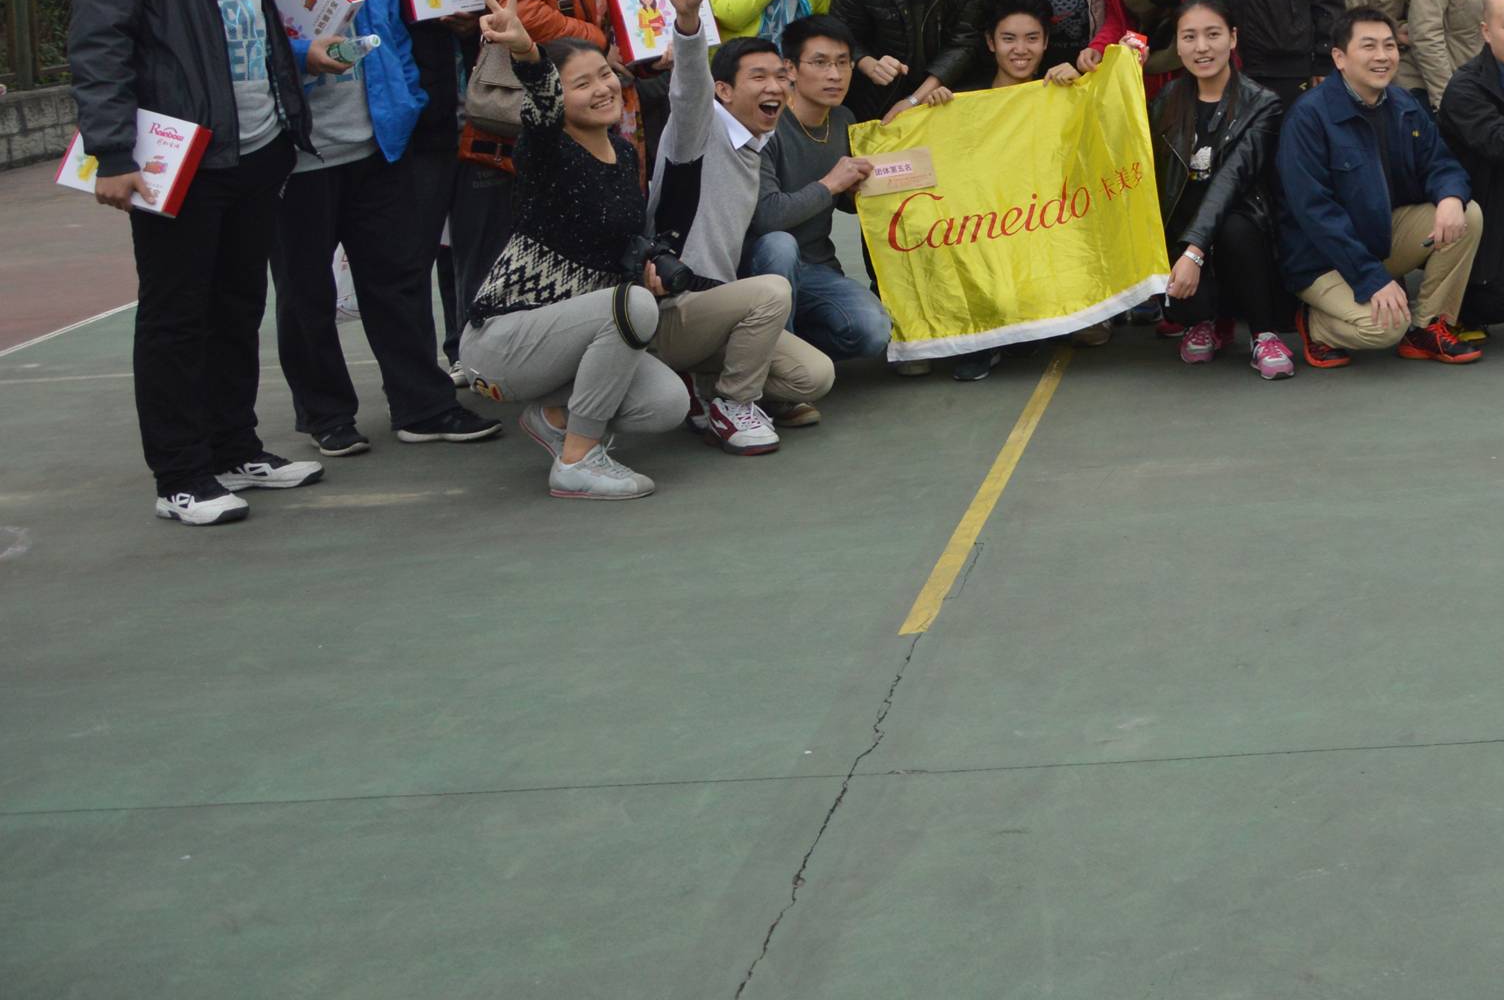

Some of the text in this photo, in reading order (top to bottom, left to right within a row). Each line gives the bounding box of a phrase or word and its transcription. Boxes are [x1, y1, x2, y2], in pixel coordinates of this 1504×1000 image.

[150, 122, 184, 142] Rainbow
[875, 163, 912, 177] 团体第五名
[1098, 162, 1143, 201] 卡美多
[888, 175, 1090, 252] Cameido
